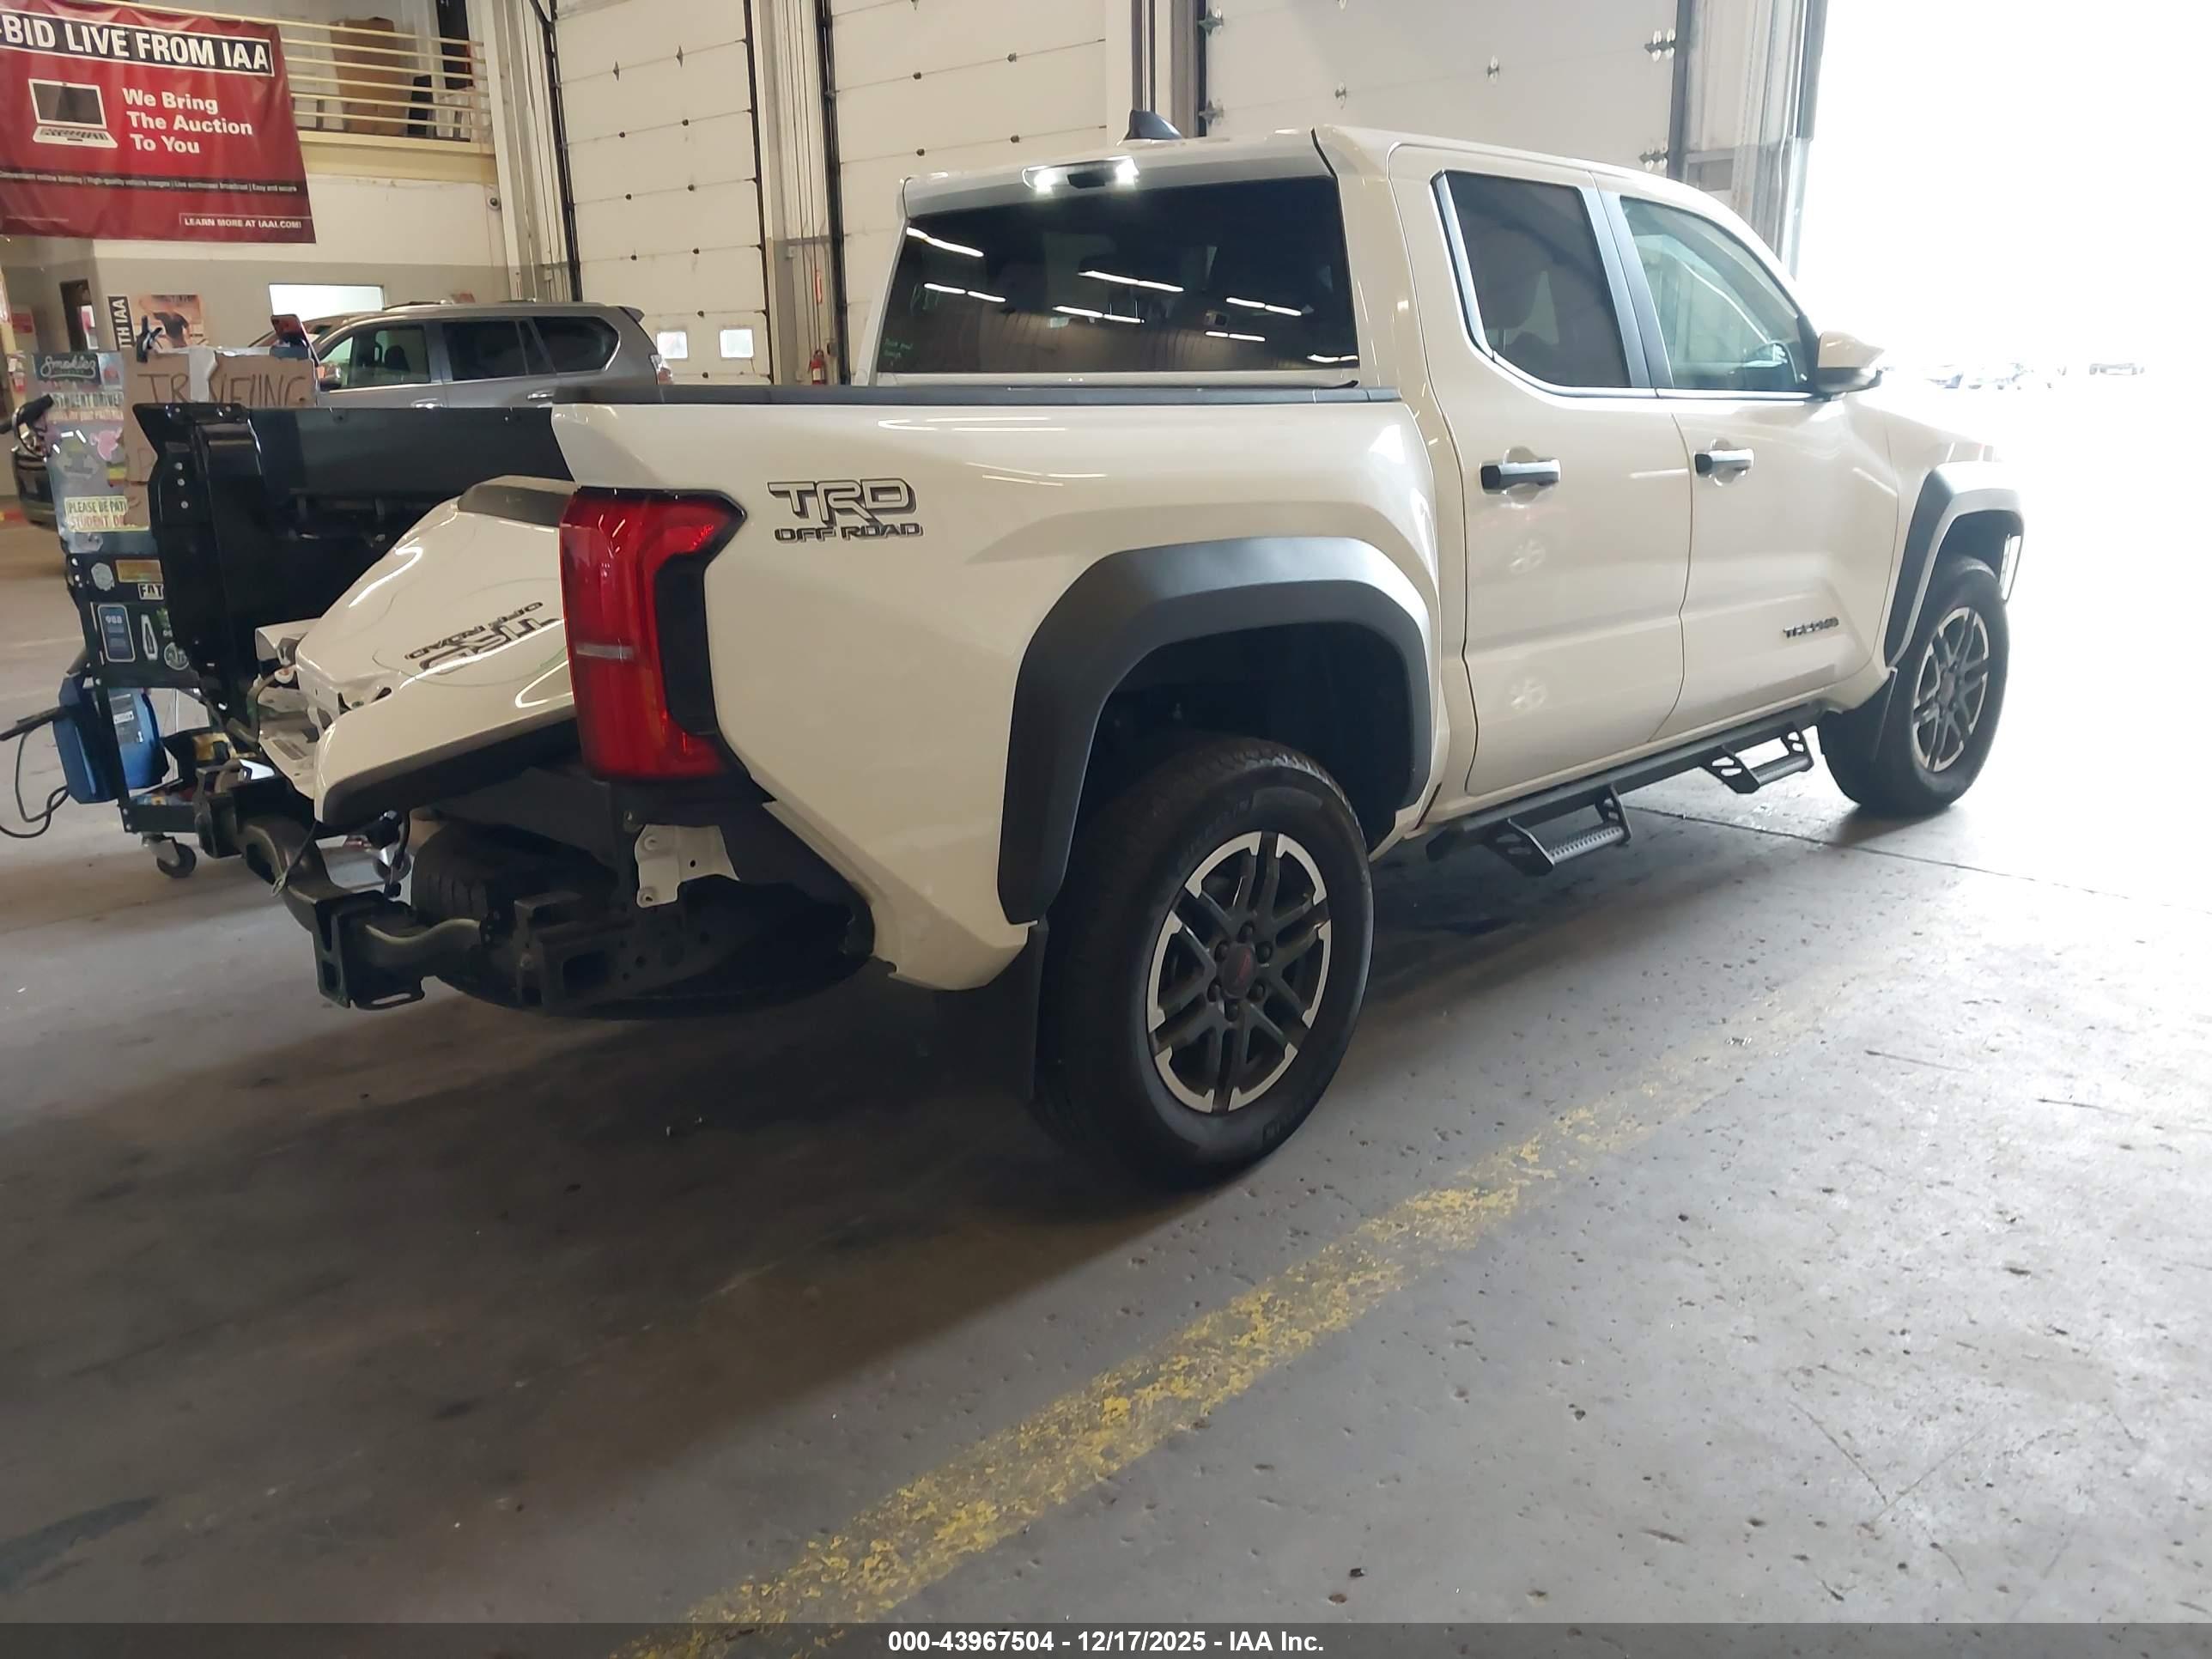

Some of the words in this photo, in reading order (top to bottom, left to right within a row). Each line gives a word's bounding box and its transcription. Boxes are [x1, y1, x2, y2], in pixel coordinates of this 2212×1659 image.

[0, 14, 55, 48] BID
[64, 22, 129, 57] LIVE
[135, 32, 216, 66] FROM
[222, 40, 269, 70] IAA
[122, 88, 156, 106] We
[161, 91, 218, 114] Bring
[126, 110, 167, 130] The
[173, 114, 253, 135] Auction
[130, 133, 156, 151] To
[161, 135, 200, 154] You
[185, 217, 215, 227] LEARN
[216, 218, 243, 228] MORE
[112, 299, 129, 323] IAA
[69, 501, 97, 514] PLEASE
[767, 477, 917, 527] TRD
[775, 526, 836, 544] OFF
[840, 522, 924, 542] ROAD
